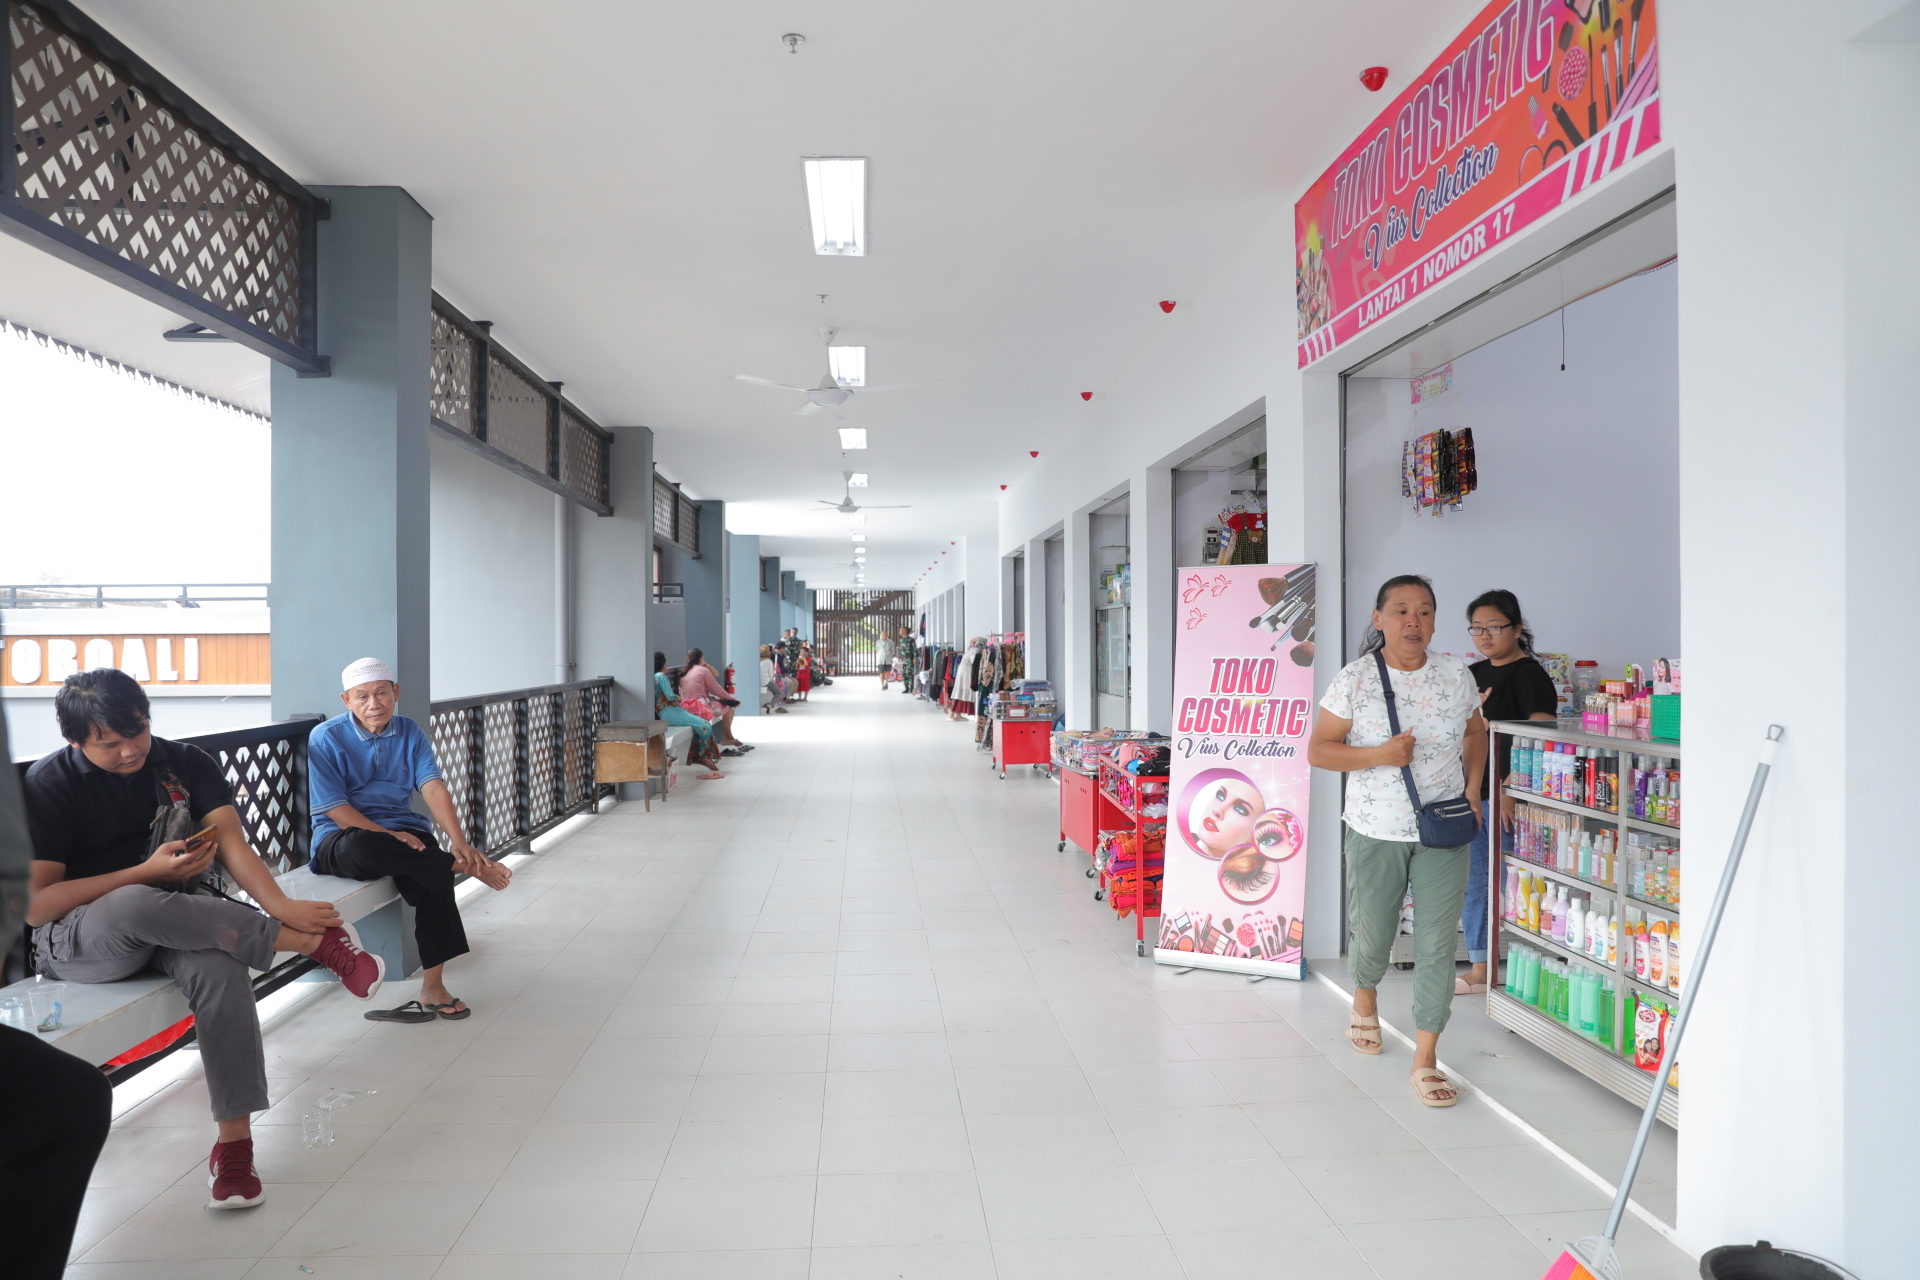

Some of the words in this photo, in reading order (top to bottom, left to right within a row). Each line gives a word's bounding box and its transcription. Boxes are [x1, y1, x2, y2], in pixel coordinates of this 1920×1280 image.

[1331, 126, 1389, 248] TOKO
[1393, 0, 1556, 195] COSMETIC
[1365, 205, 1409, 270] Vius
[1411, 142, 1498, 241] Collection
[1358, 278, 1407, 329] LANTAI
[1410, 270, 1419, 294] 1
[1423, 226, 1486, 288] NOMOR
[1492, 202, 1516, 241] 17
[0, 637, 199, 684] OBOALI
[1209, 657, 1278, 695] TOKO
[1177, 697, 1310, 738] COSMETIC
[1177, 737, 1221, 759] Vius
[1223, 739, 1298, 760] Collection
